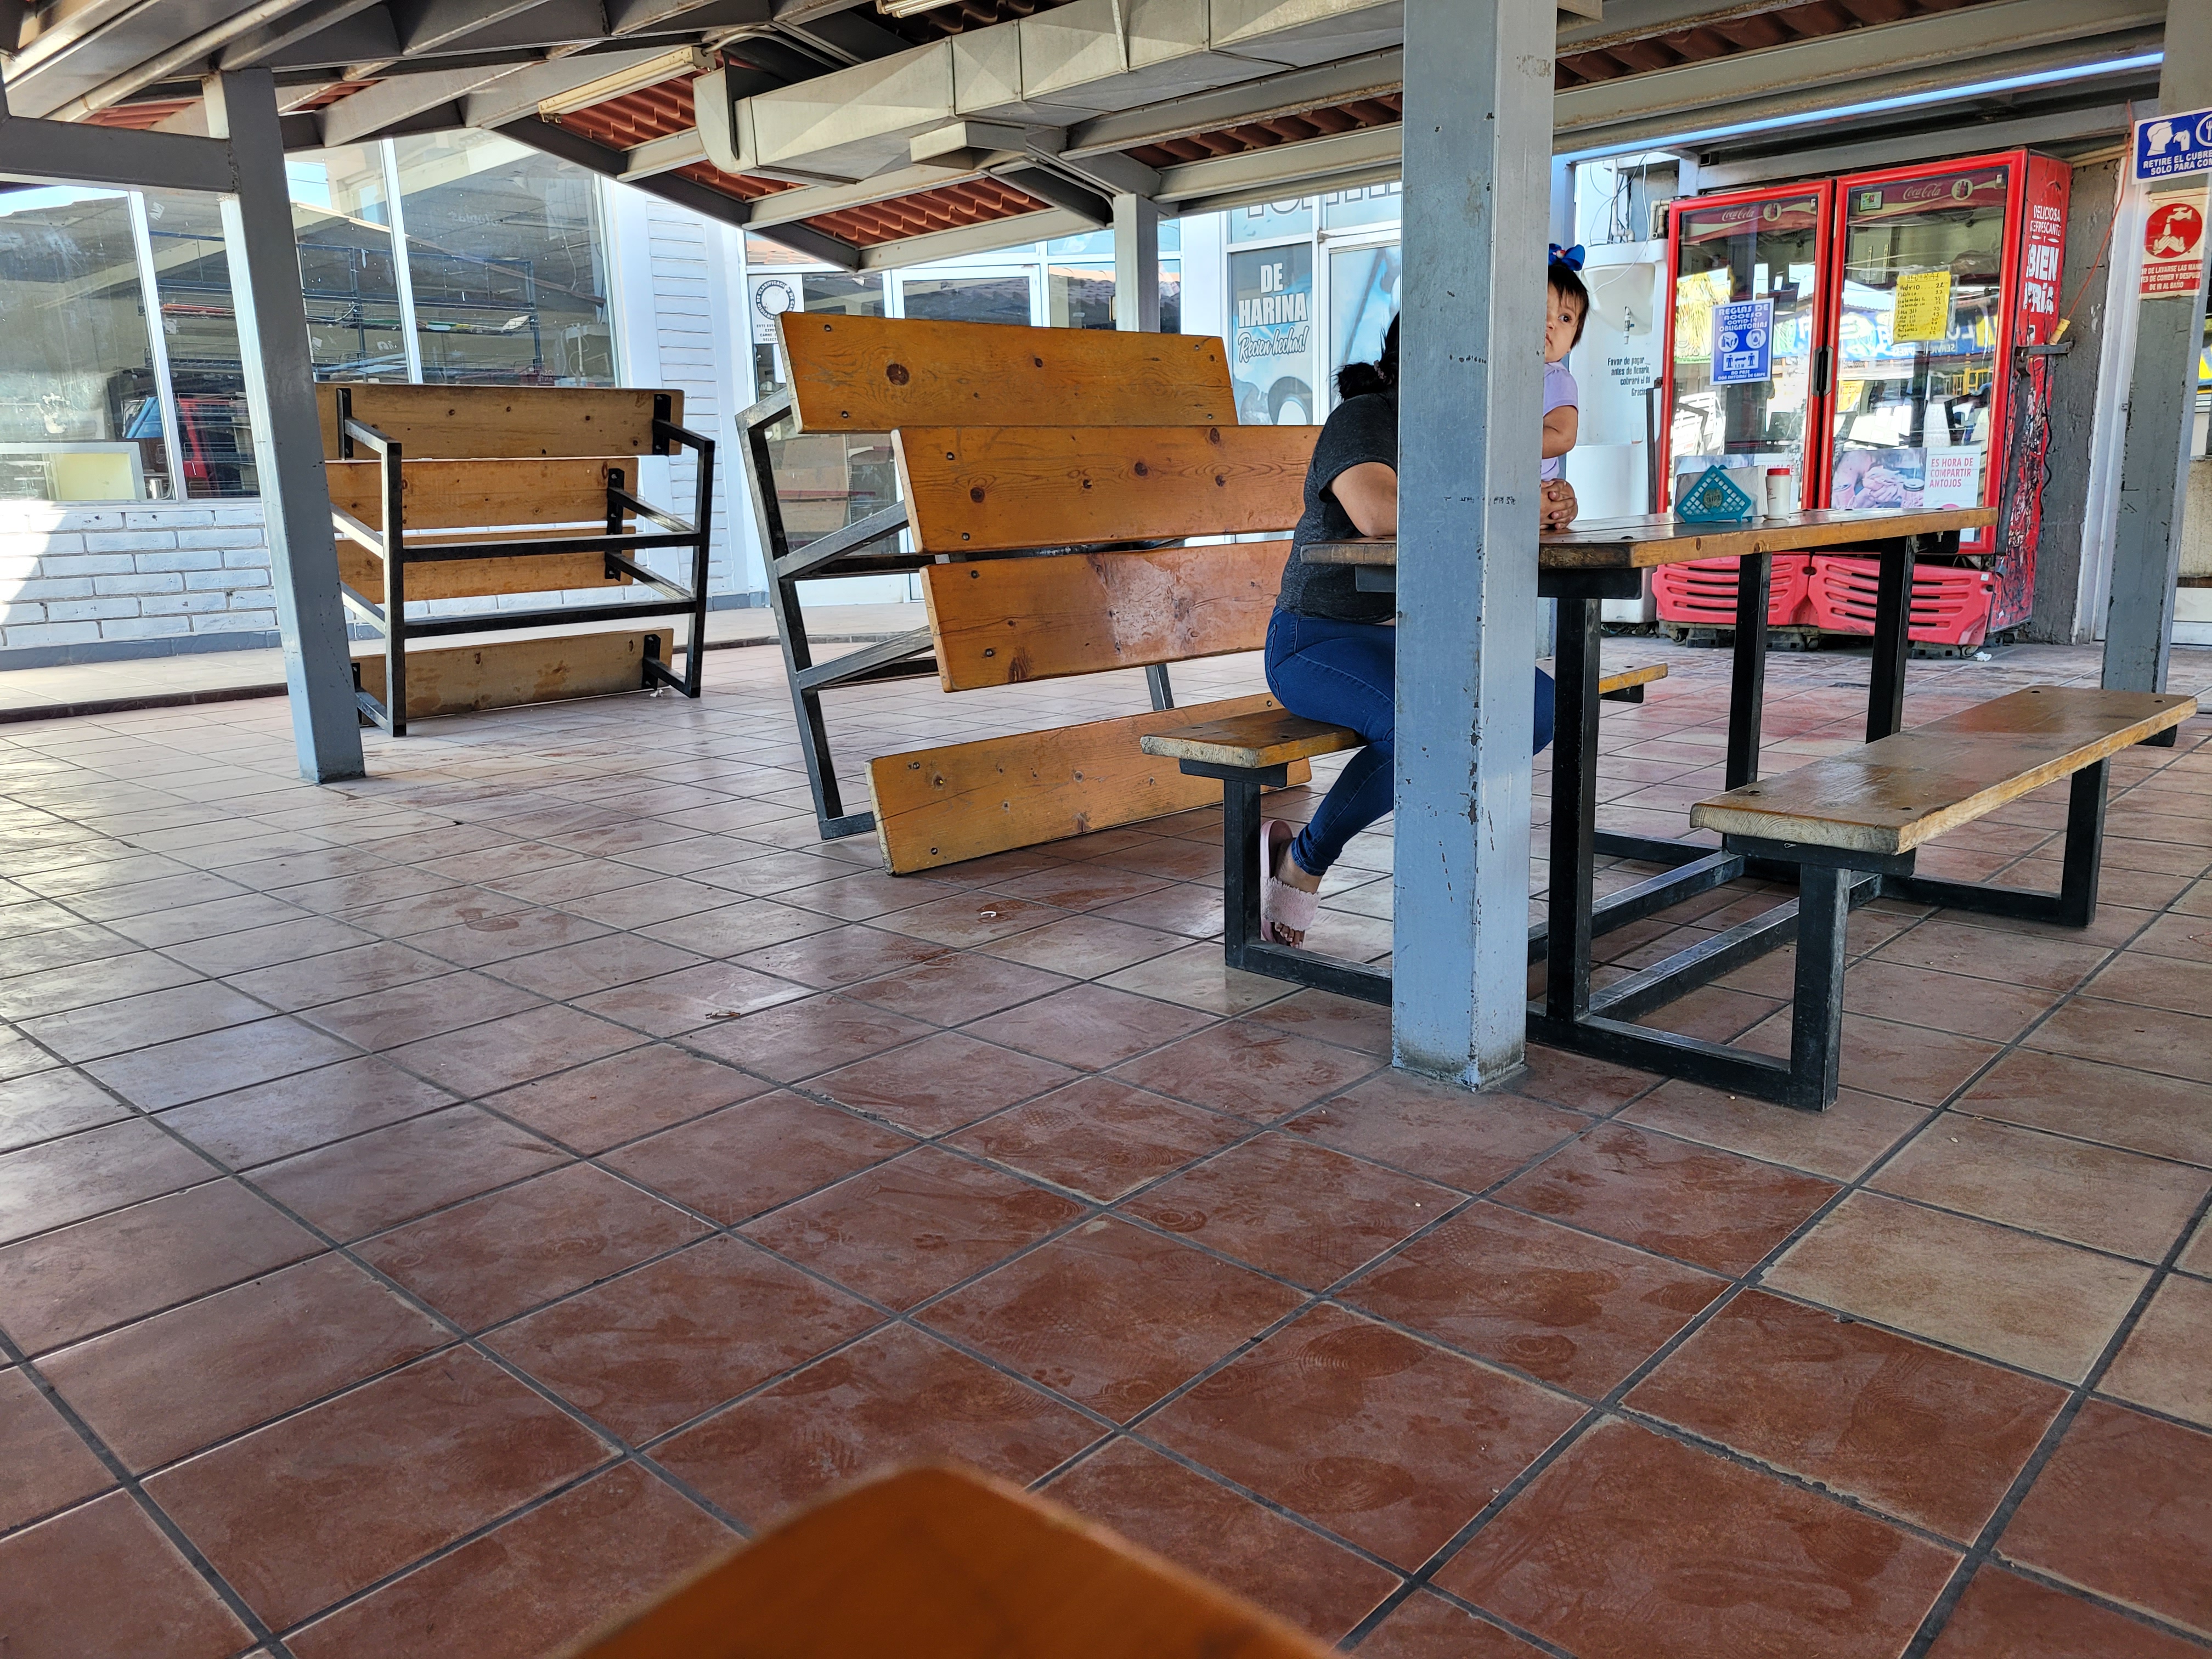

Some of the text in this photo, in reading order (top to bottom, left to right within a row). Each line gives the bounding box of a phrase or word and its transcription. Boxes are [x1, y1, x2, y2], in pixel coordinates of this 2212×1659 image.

[2143, 156, 2172, 168] RETIRE
[2174, 155, 2184, 163] EL
[2151, 165, 2172, 176] SOLO
[2174, 161, 2195, 171] PARA
[2033, 205, 2061, 222] DELICIOSA
[2025, 244, 2059, 281] BIEN
[1260, 263, 1284, 293] DE
[758, 280, 791, 294] CLASIFICACIN
[2023, 281, 2054, 315] FRÍA
[1238, 292, 1308, 328] HARINA
[1719, 306, 1752, 315] REGLAS
[1724, 312, 1762, 320] ACCESO
[1727, 317, 1758, 325] COVID-19
[1719, 321, 1768, 332] OBLIGATORIAS
[1607, 357, 1645, 366] Favor de pagar
[1611, 368, 1625, 376] antes
[1626, 366, 1632, 375] de
[1931, 457, 1973, 467] ES HORA DE
[1930, 468, 1971, 477] COMPARTIR
[1929, 478, 1962, 488] ANTOJOS
